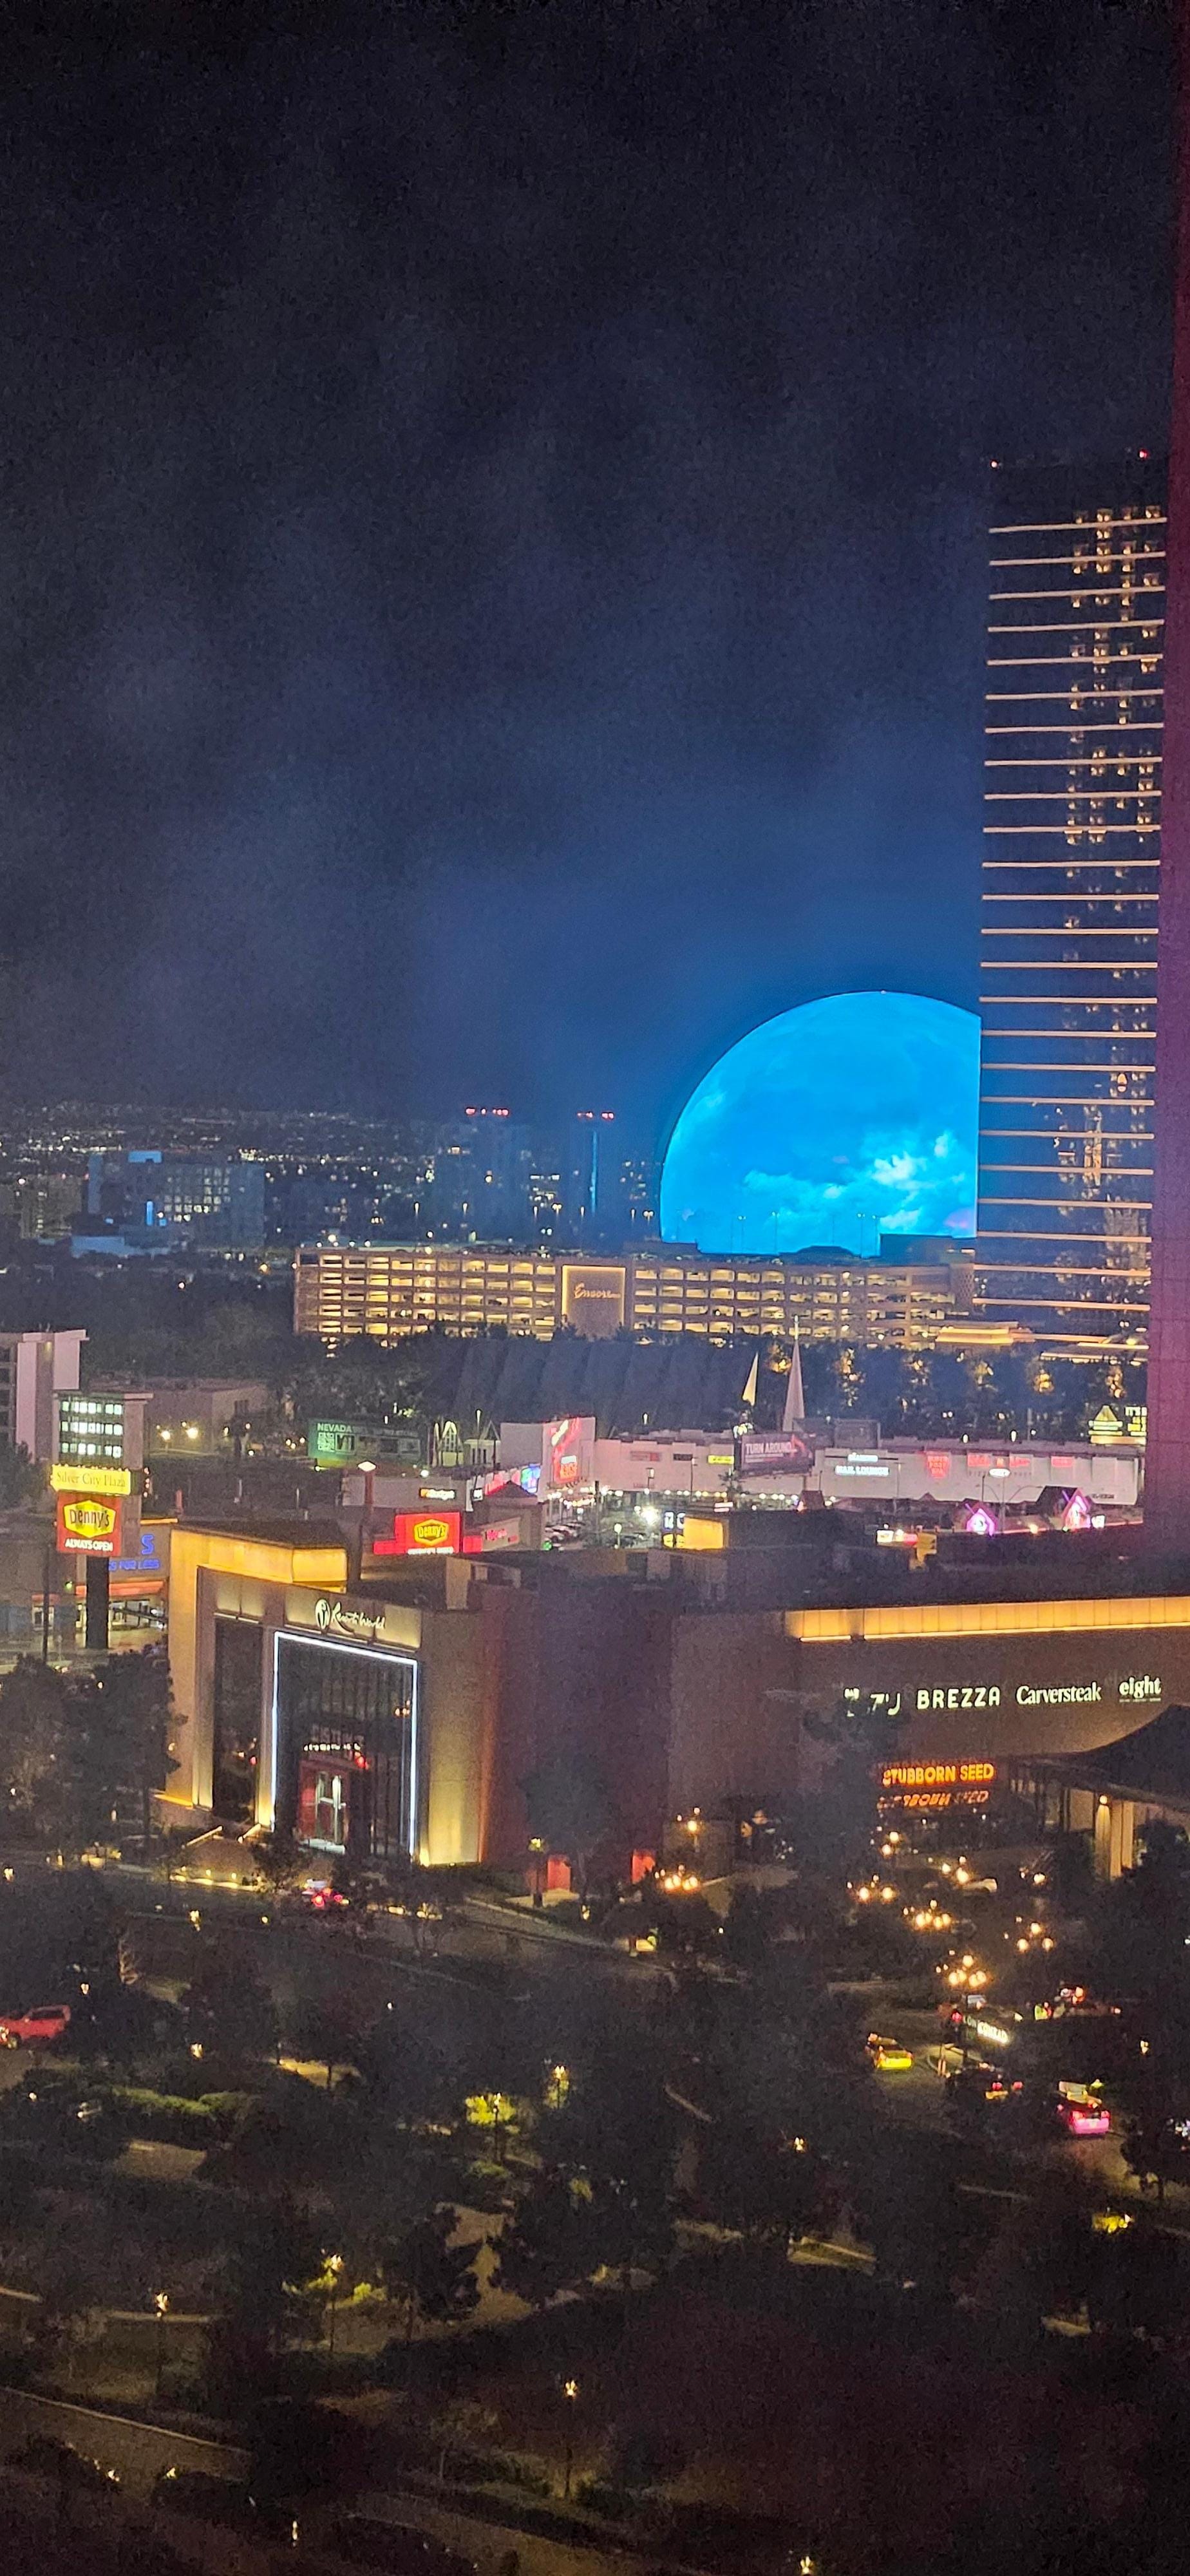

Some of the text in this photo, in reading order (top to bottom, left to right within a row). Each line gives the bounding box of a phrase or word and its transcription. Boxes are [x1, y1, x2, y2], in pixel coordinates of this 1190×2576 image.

[317, 1423, 352, 1433] NEVADA
[746, 1443, 764, 1454] TURN
[56, 1472, 126, 1488] Silver City Plaza
[69, 1508, 110, 1528] Denny's
[418, 1524, 446, 1539] Denny's
[65, 1538, 113, 1551] ALWAYS OPEN
[916, 1687, 1001, 1710] BREZZA
[1016, 1681, 1102, 1705] Carversteak
[1119, 1675, 1162, 1699] eight
[882, 1763, 994, 1788] STUBBORN SEED
